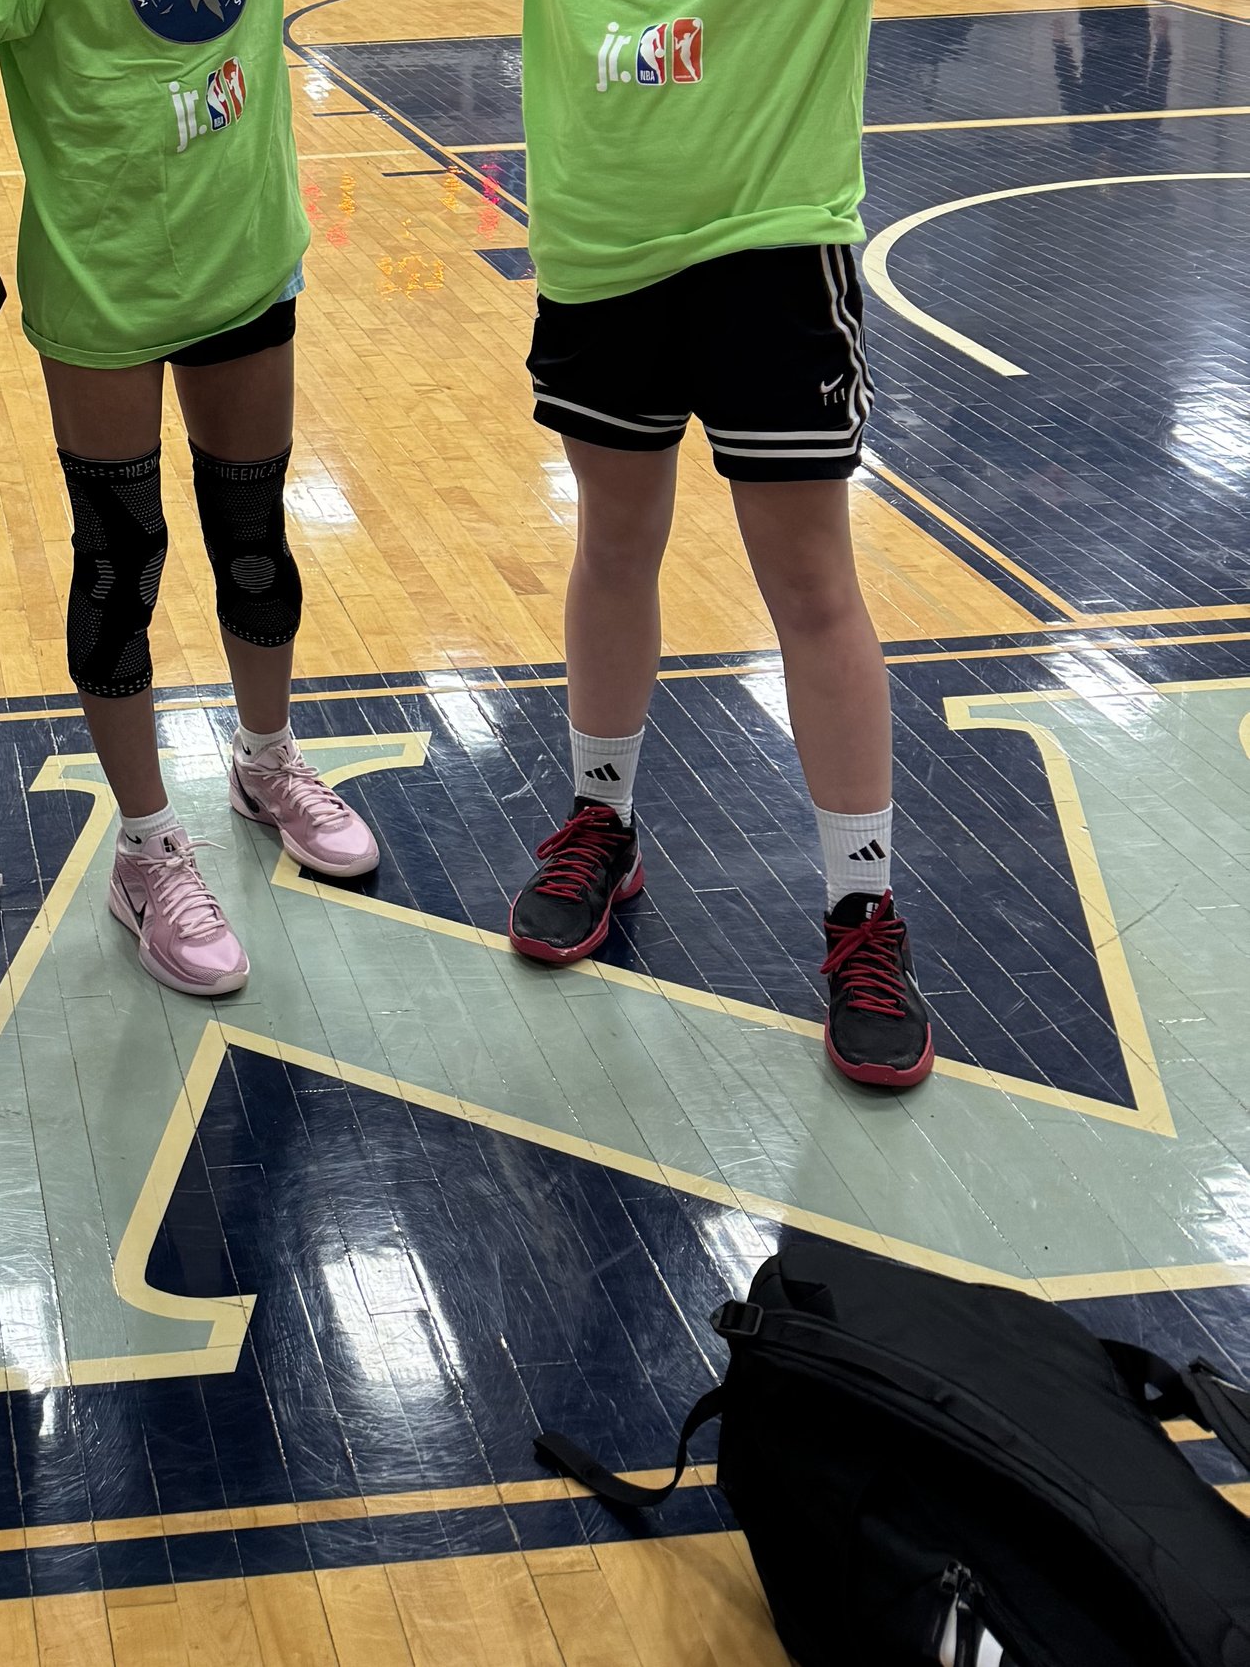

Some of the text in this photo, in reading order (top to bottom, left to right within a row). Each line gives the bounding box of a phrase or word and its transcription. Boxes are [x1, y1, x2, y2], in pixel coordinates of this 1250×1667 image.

[596, 21, 656, 92] jr. NBA
[168, 80, 208, 154] jr.
